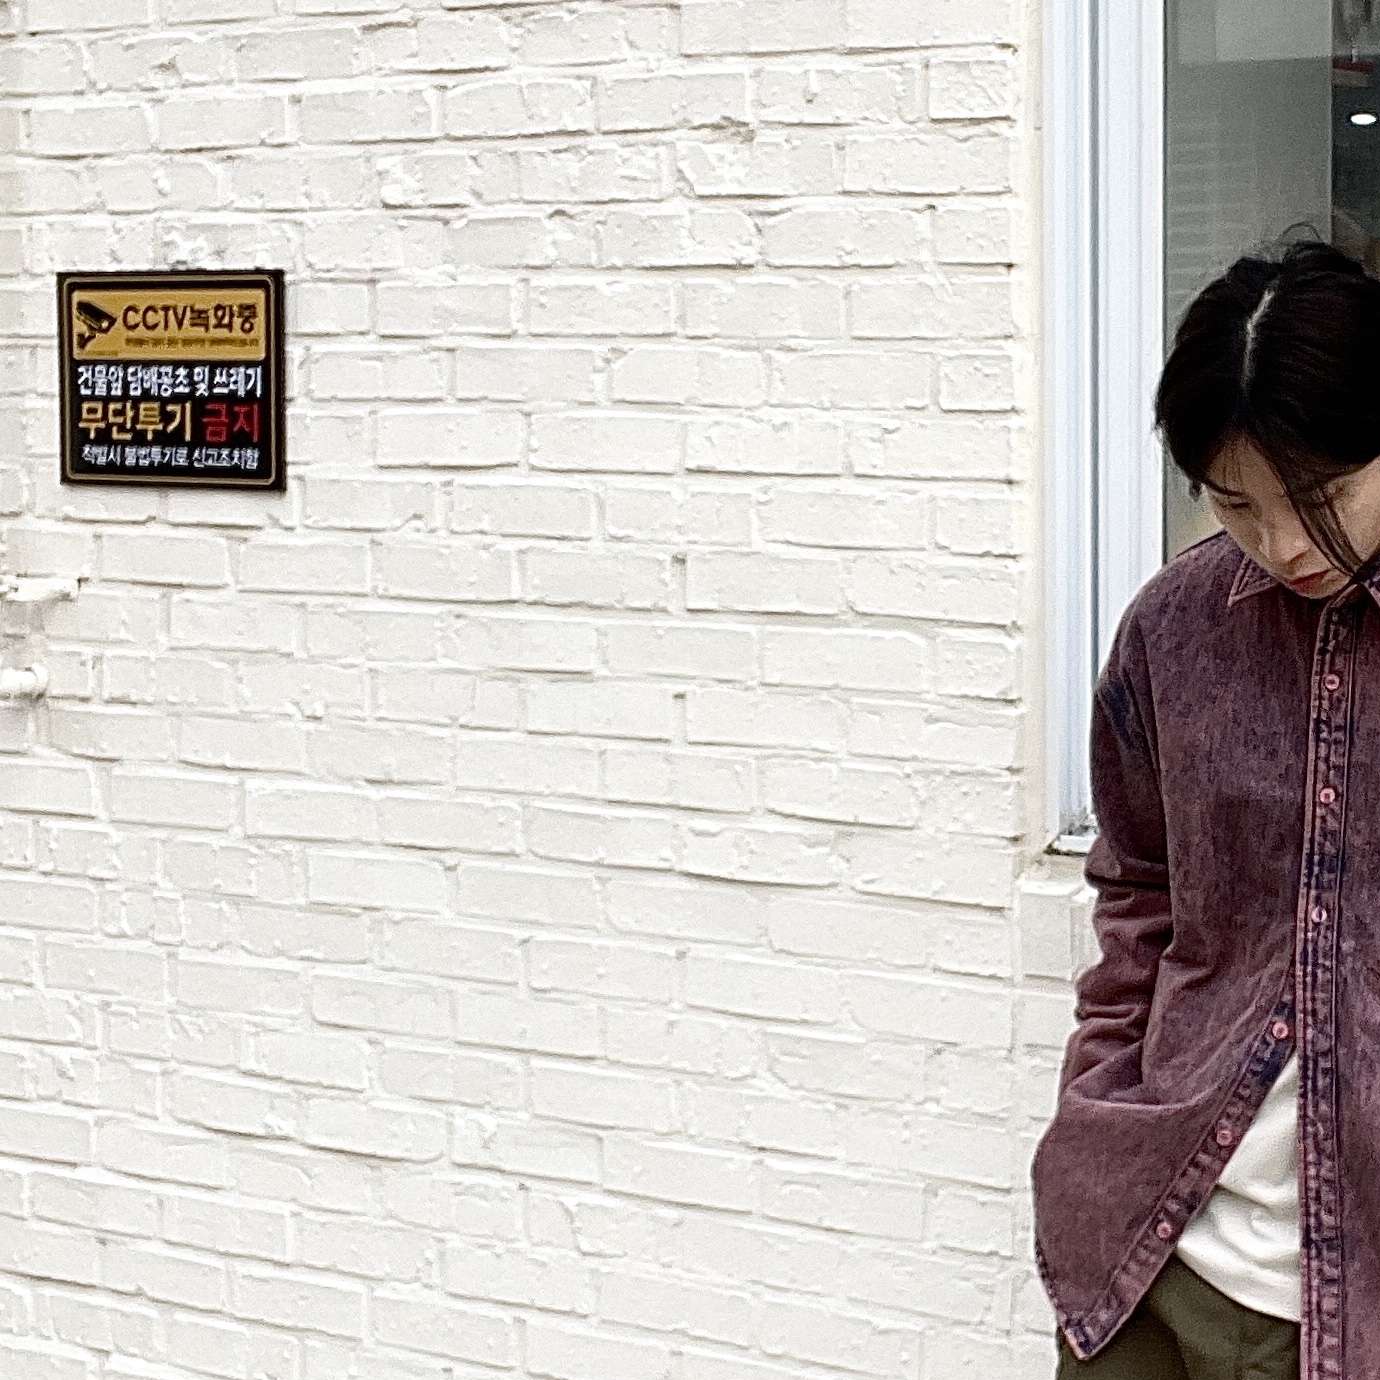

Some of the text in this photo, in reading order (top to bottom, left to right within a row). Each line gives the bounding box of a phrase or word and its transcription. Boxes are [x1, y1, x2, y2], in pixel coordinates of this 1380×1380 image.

[193, 365, 210, 397] 및
[213, 365, 263, 398] 쓰레기
[78, 400, 260, 443] 무단투기 금지
